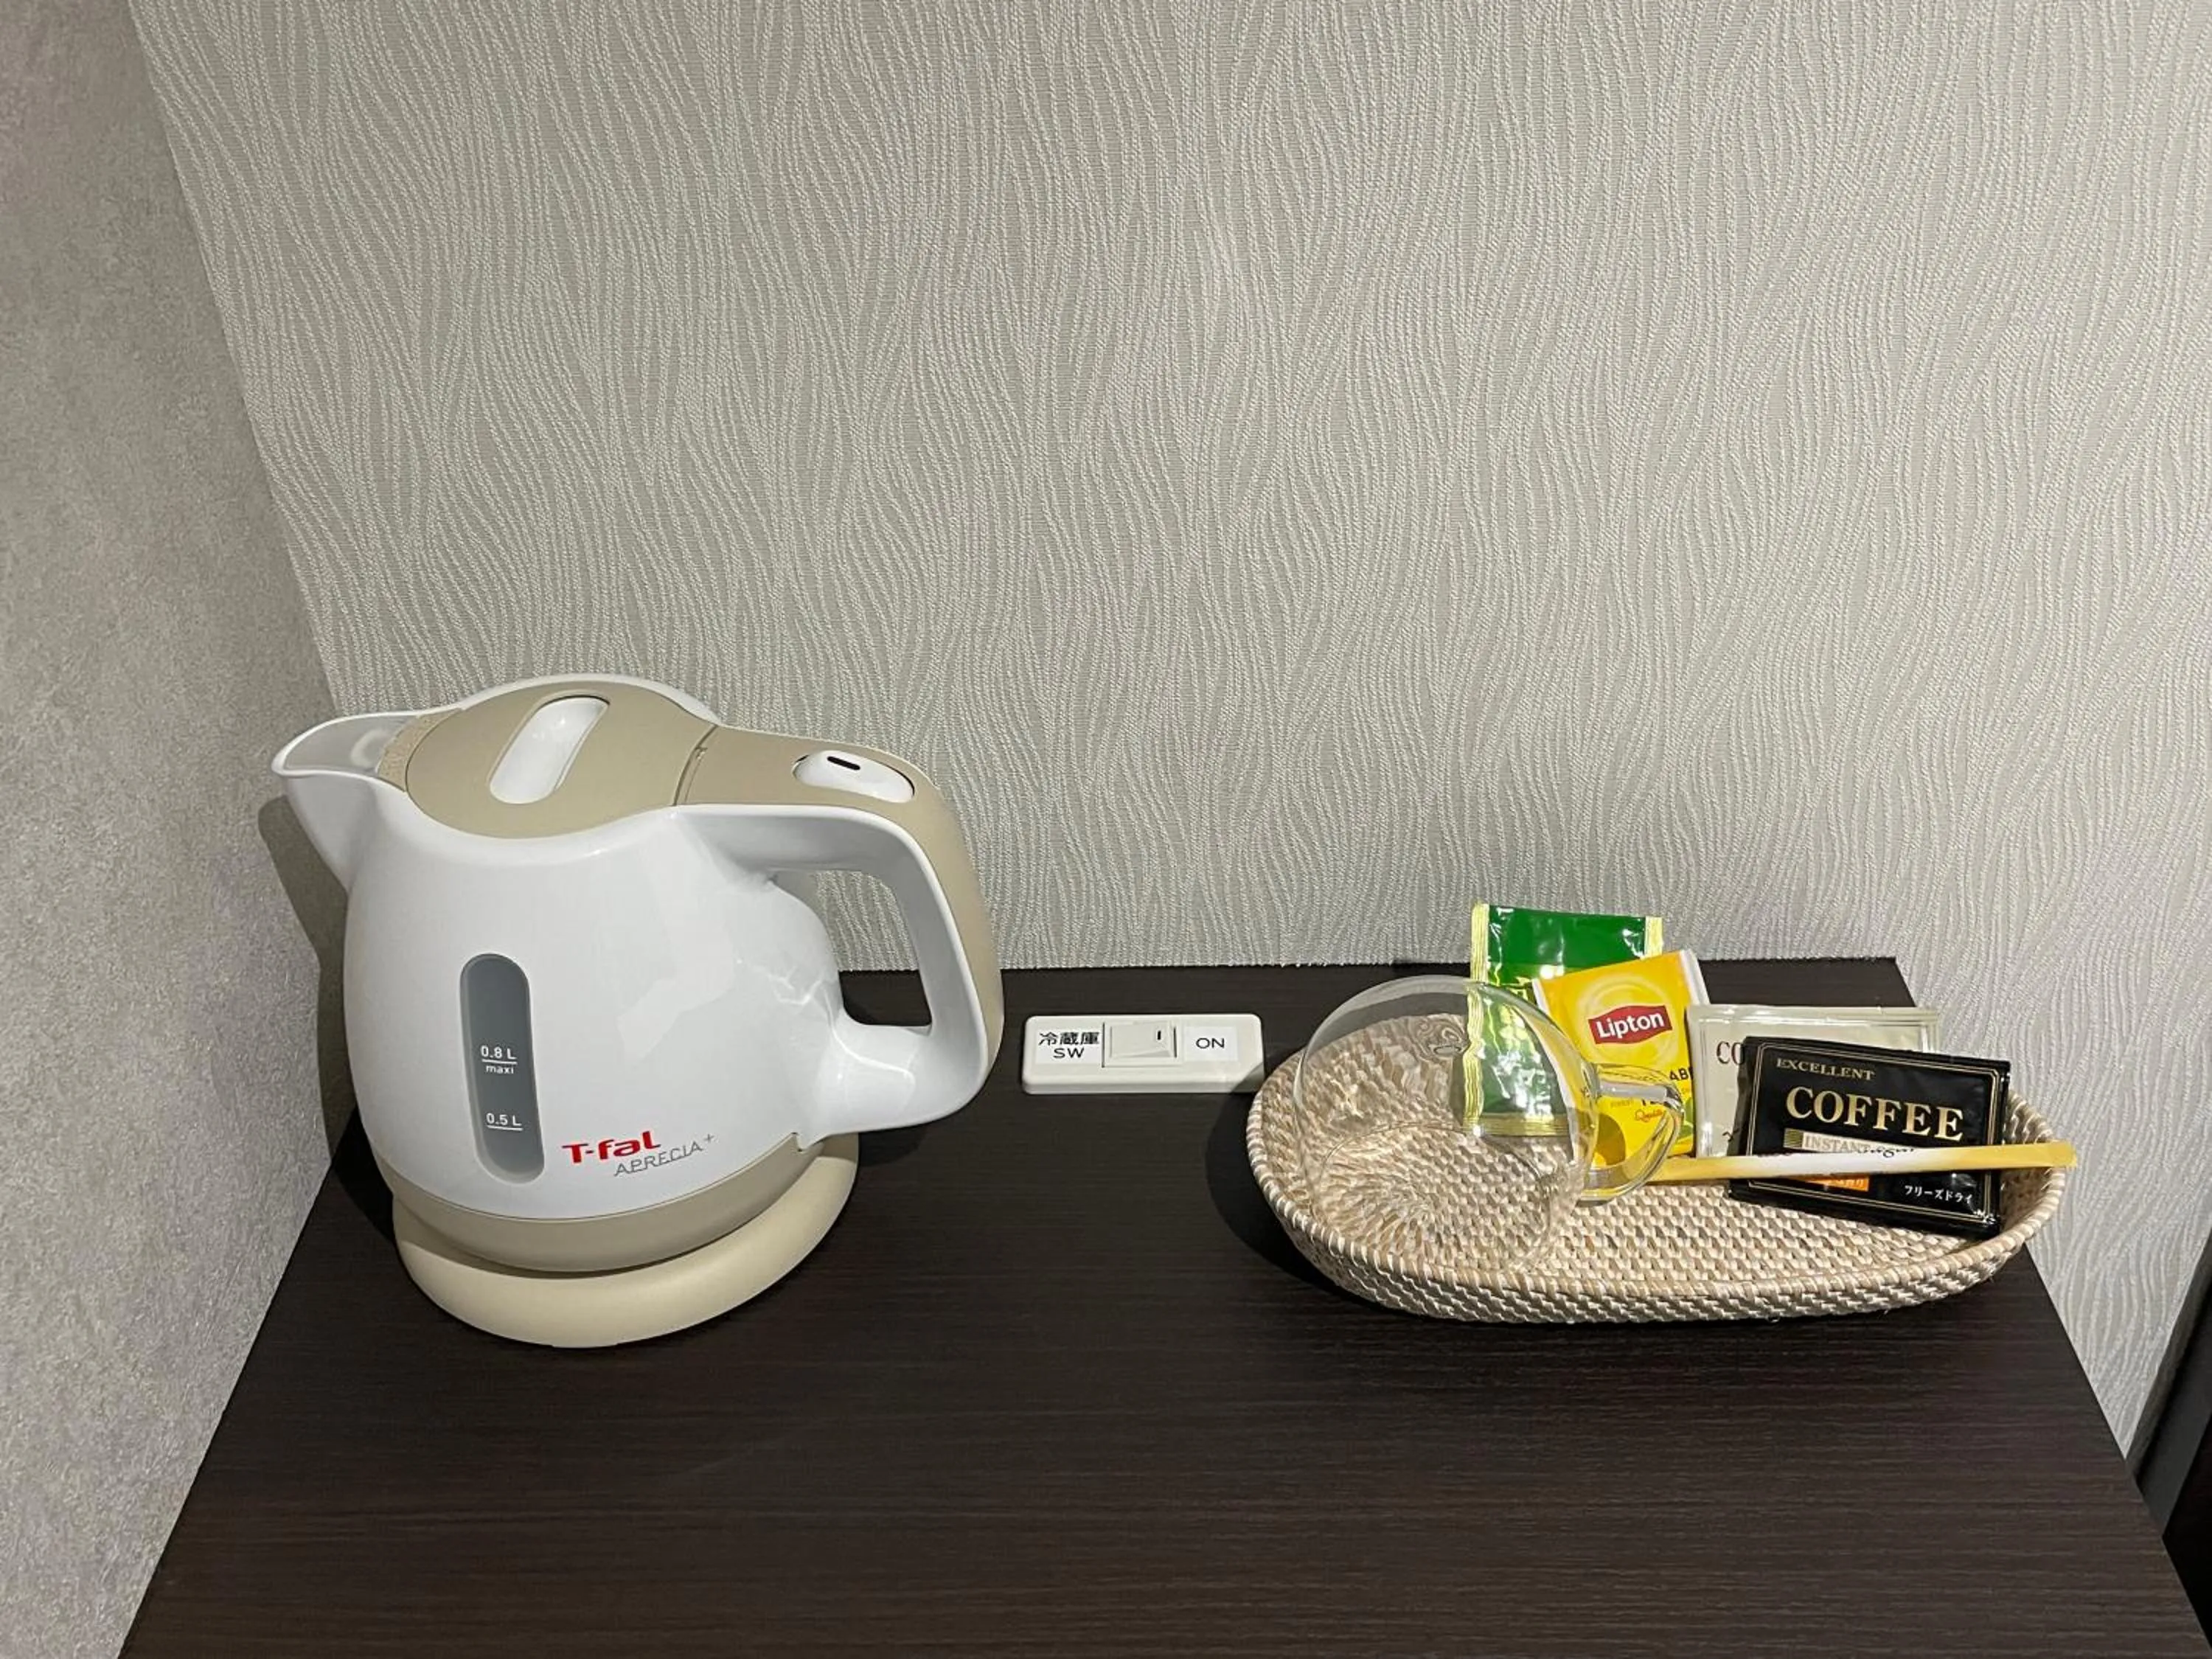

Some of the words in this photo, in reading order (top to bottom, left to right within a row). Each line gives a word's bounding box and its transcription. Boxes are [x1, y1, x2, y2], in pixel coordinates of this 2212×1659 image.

[1596, 1011, 1665, 1039] Lipton
[1039, 1032, 1100, 1046] 冷蔵庫
[1195, 1037, 1225, 1049] ON
[1053, 1048, 1085, 1059] SW
[486, 1065, 514, 1074] maxi
[1775, 1057, 1877, 1081] EXCELLENT
[1786, 1086, 1964, 1141] COFFEE
[561, 1130, 661, 1164] T-fal
[1904, 1184, 1973, 1204] フリーズドライ
